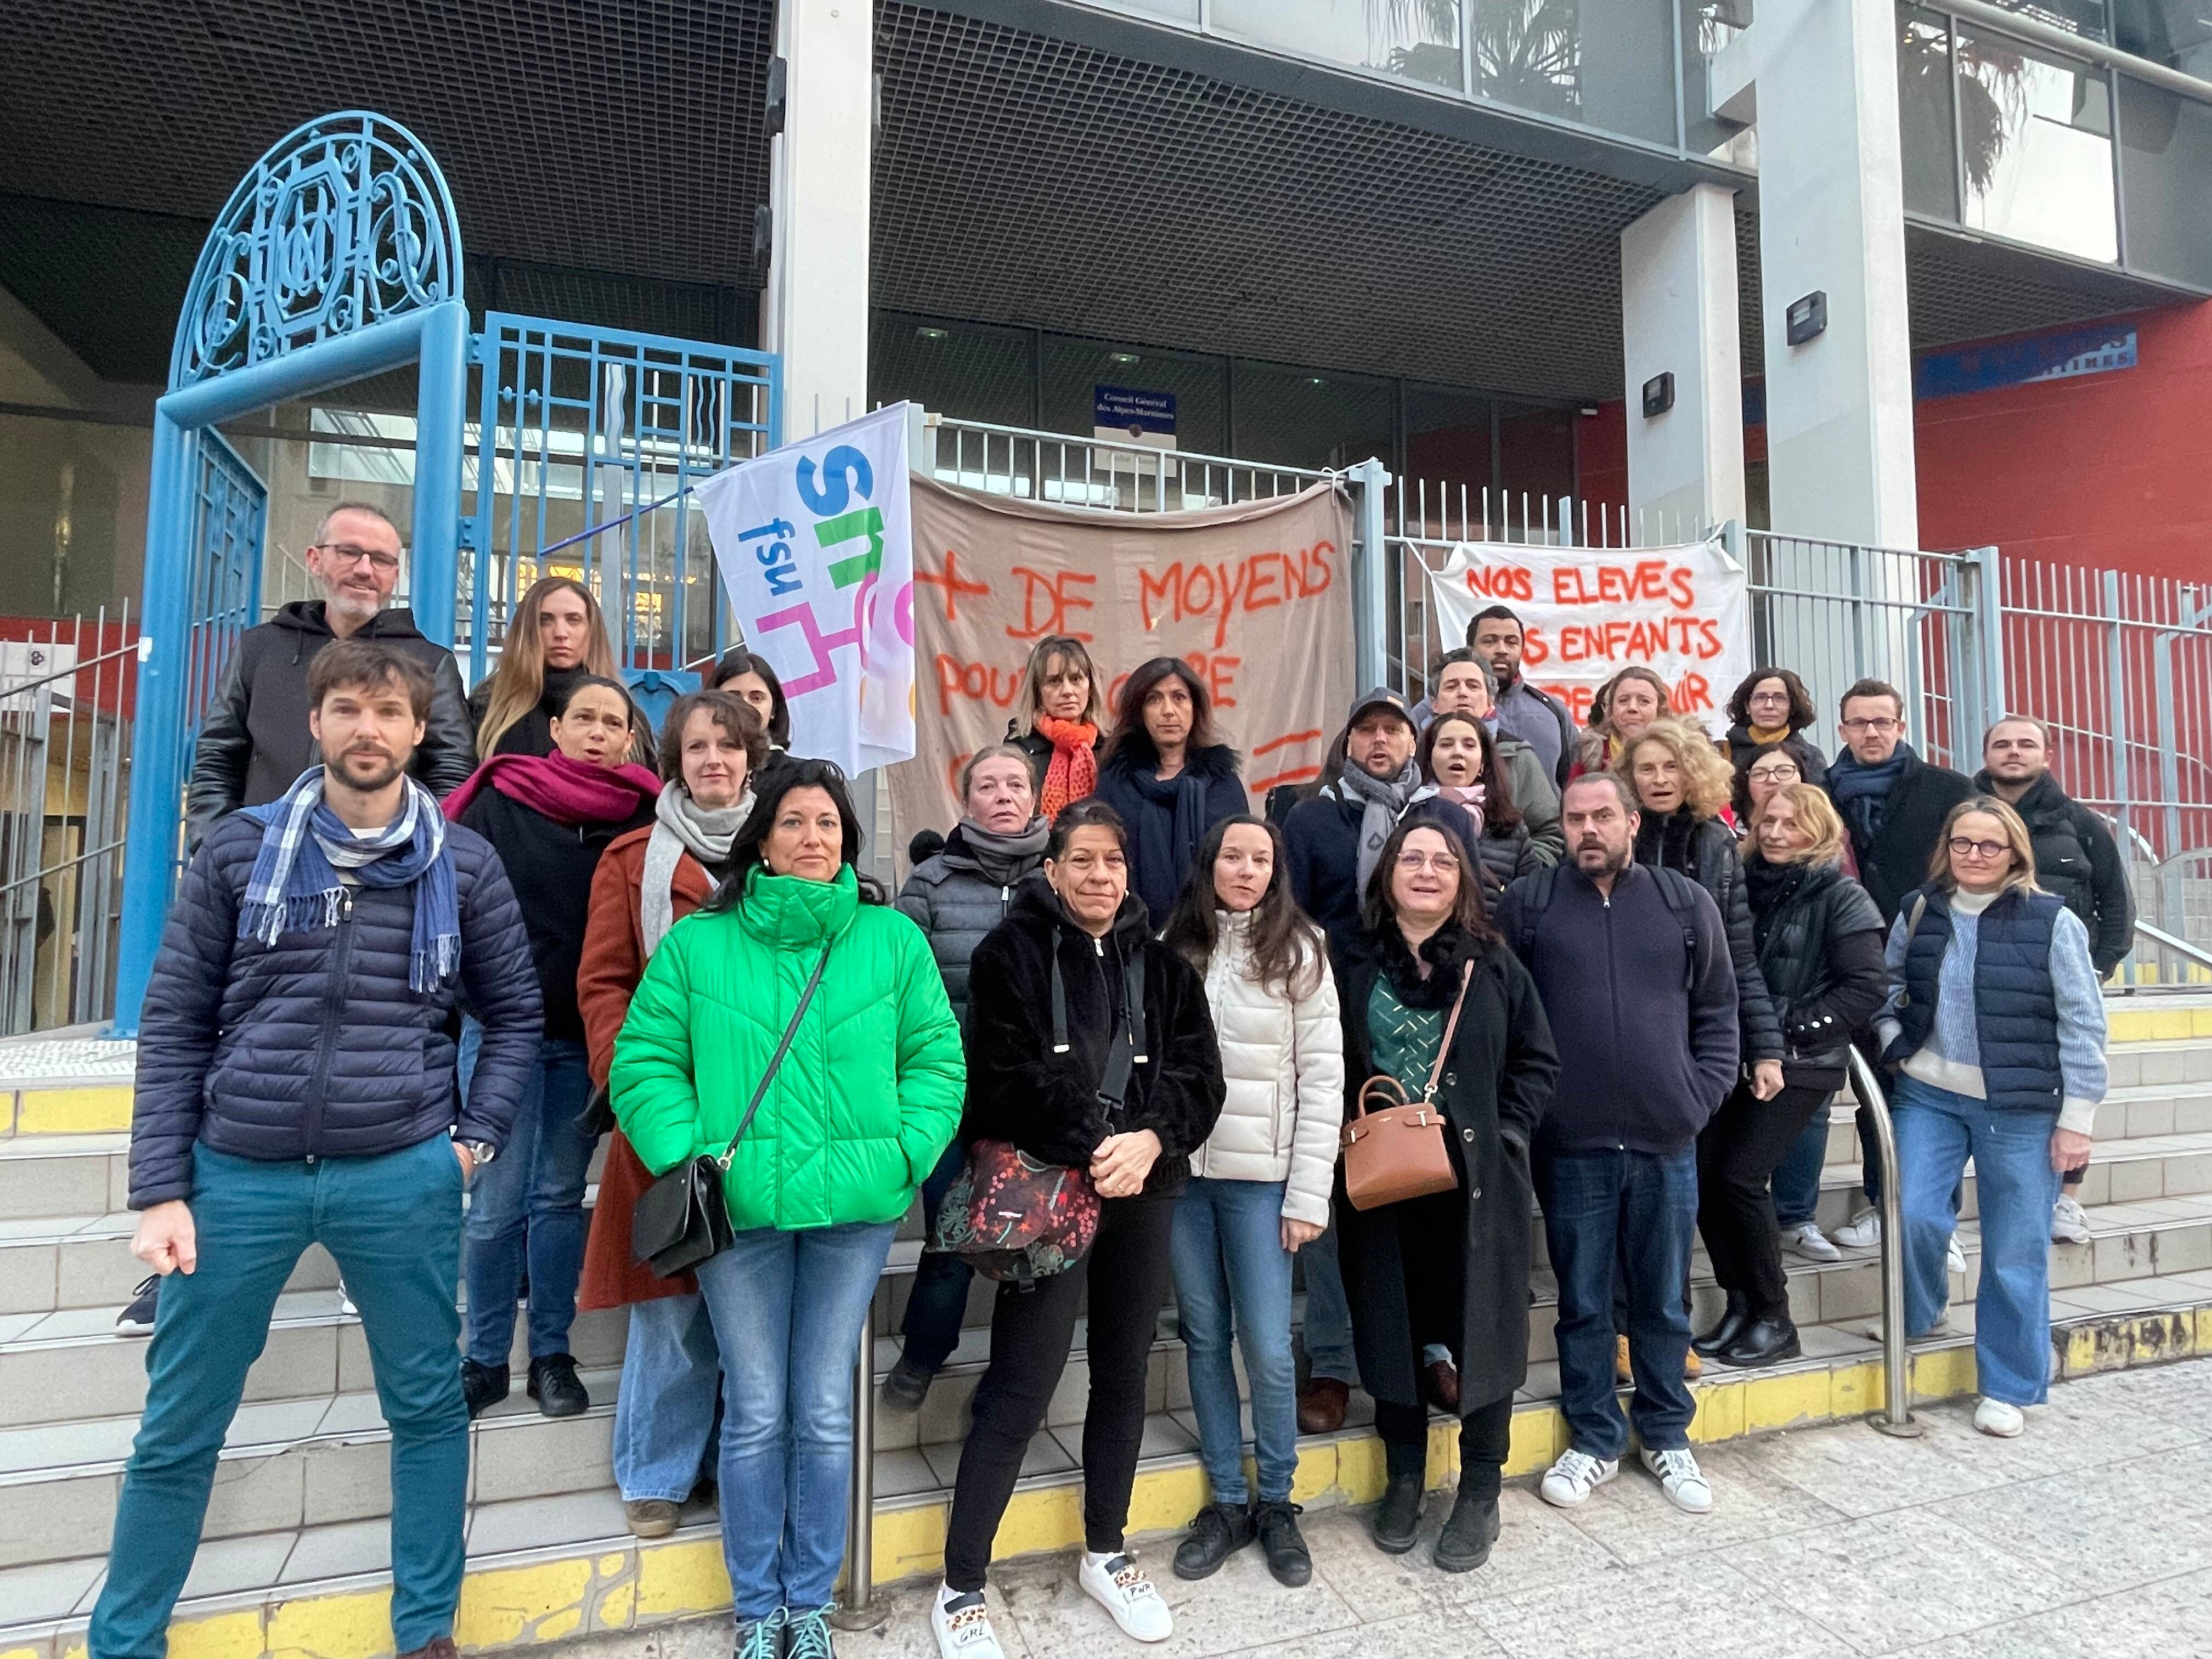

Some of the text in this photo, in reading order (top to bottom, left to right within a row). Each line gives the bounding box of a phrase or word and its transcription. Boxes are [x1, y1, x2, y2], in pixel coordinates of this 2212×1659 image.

[1097, 403, 1111, 412] des
[737, 517, 803, 597] fsu
[1466, 560, 1694, 610] NOS ELEVES
[1006, 566, 1097, 643] DE
[1139, 540, 1335, 648] MOYENS
[1560, 616, 1723, 663] ENFANTS
[936, 653, 1025, 717] POU
